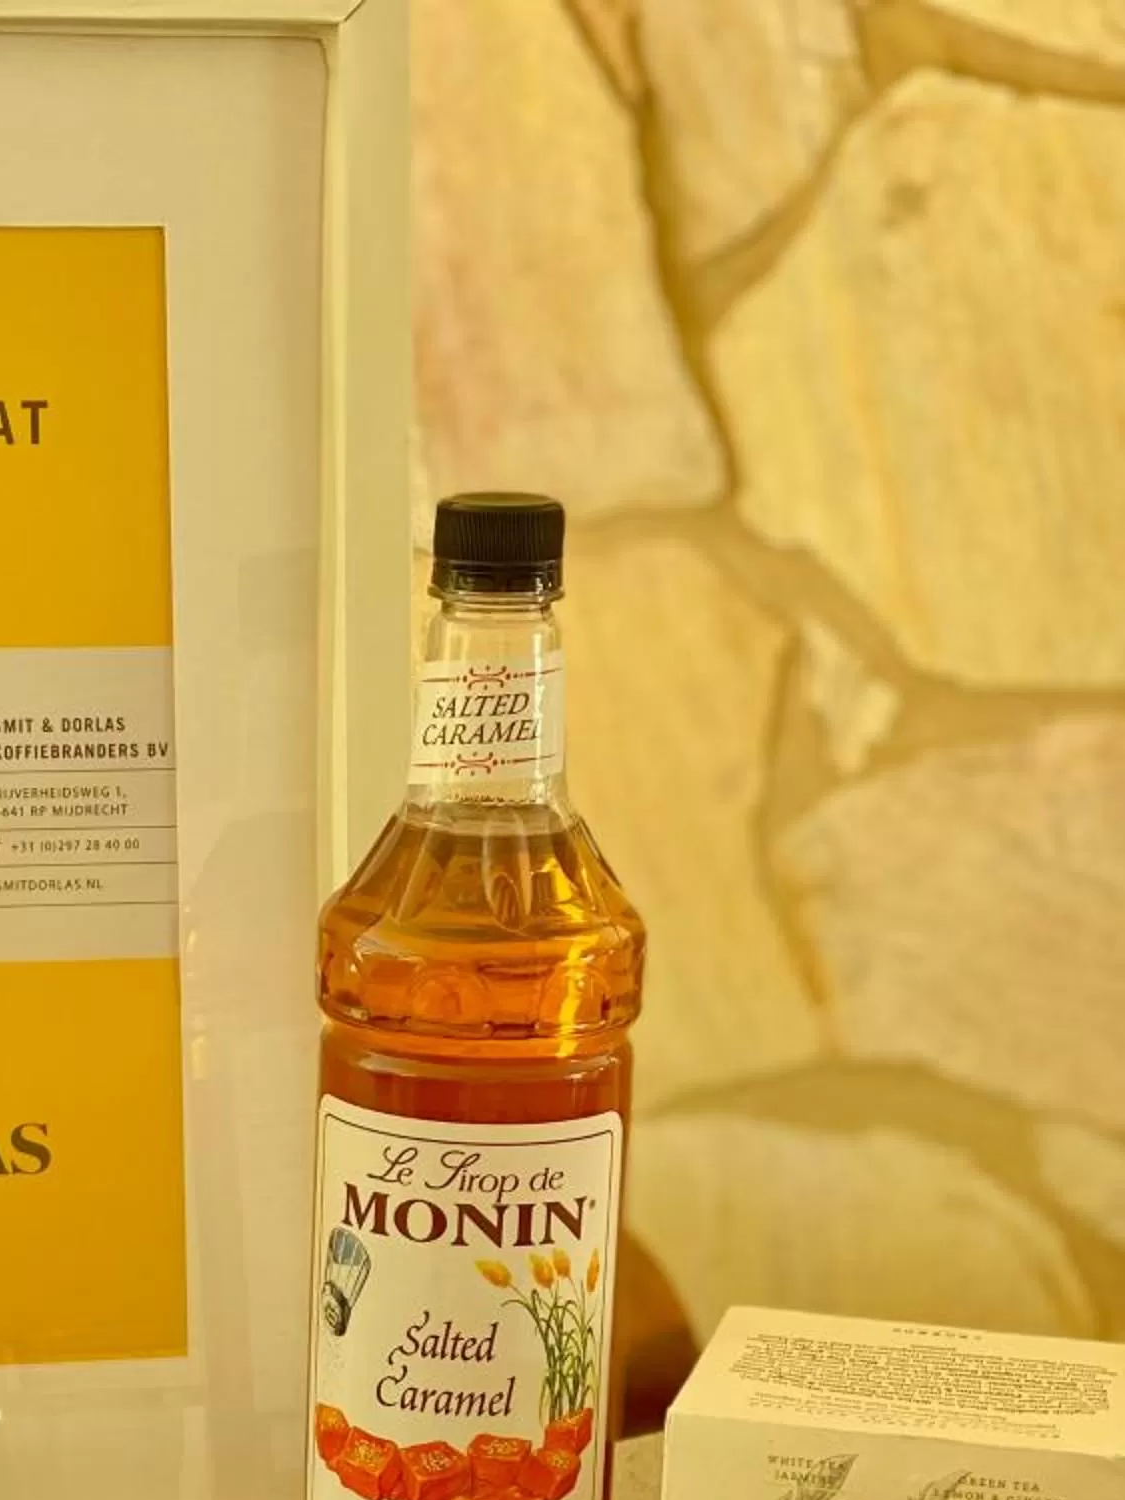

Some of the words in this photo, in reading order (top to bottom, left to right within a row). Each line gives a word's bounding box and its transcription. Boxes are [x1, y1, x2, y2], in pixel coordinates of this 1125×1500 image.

[432, 692, 530, 718] SALTED
[41, 717, 54, 733] &
[61, 716, 126, 733] DORLAS
[147, 743, 169, 757] BV
[52, 803, 129, 817] MIJDRECHT
[366, 1145, 419, 1188] Le
[425, 1149, 520, 1203] Sirop
[529, 1167, 565, 1191] de
[341, 1181, 588, 1250] MONIN
[388, 1310, 499, 1366] Salted
[376, 1365, 516, 1418] Caramel
[1012, 1480, 1041, 1493] TEA
